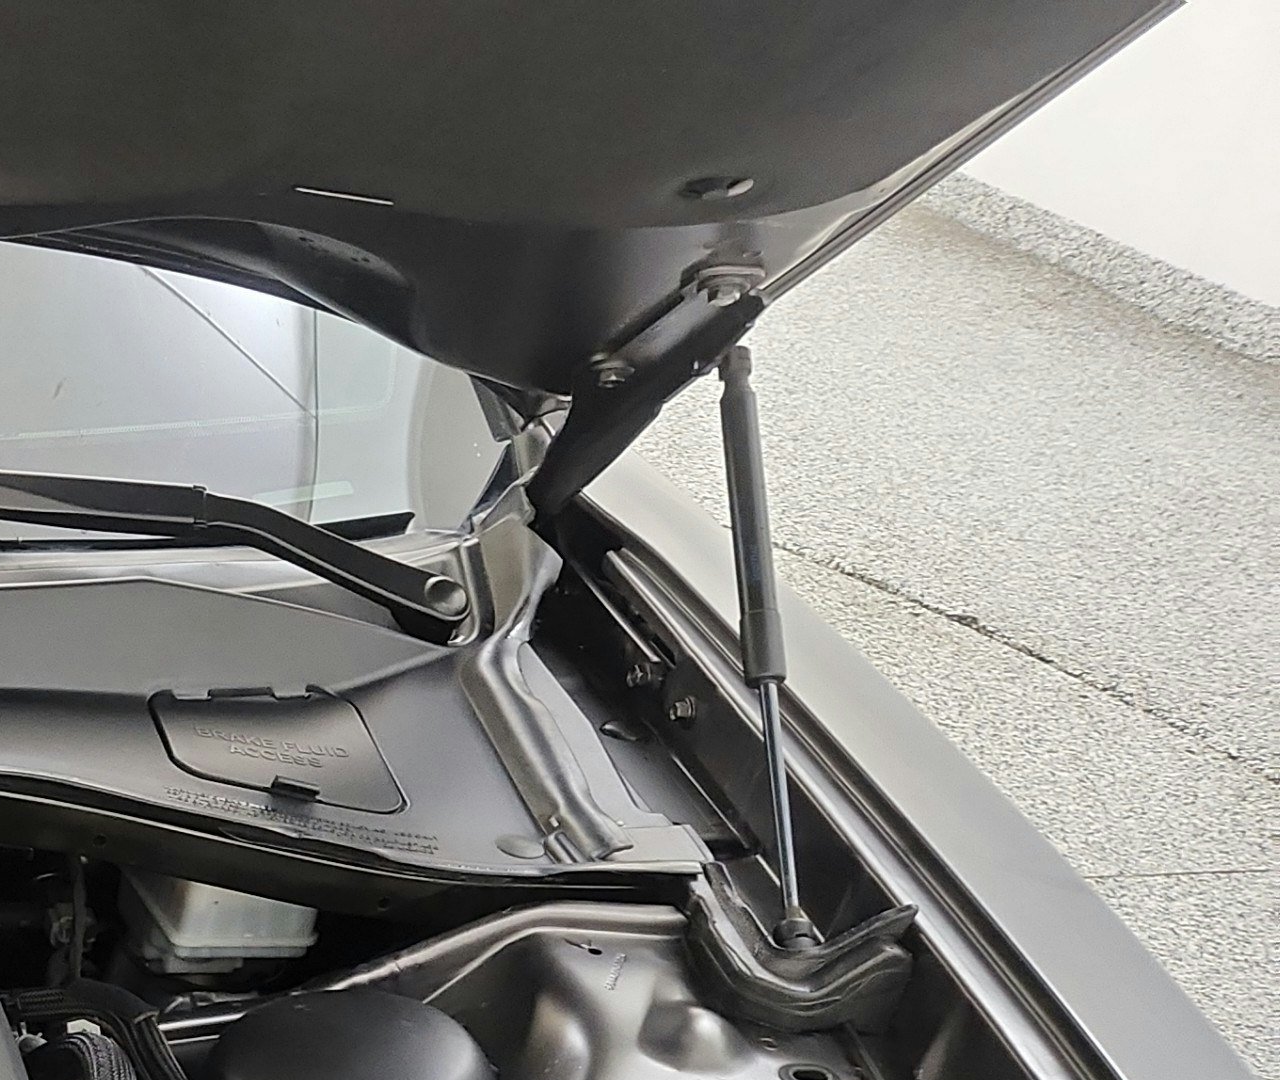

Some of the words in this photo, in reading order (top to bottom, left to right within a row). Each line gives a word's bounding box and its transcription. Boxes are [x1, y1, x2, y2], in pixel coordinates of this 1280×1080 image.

[195, 727, 275, 748] BRAKE
[282, 741, 350, 758] FLUID
[231, 745, 323, 767] ACCESS
